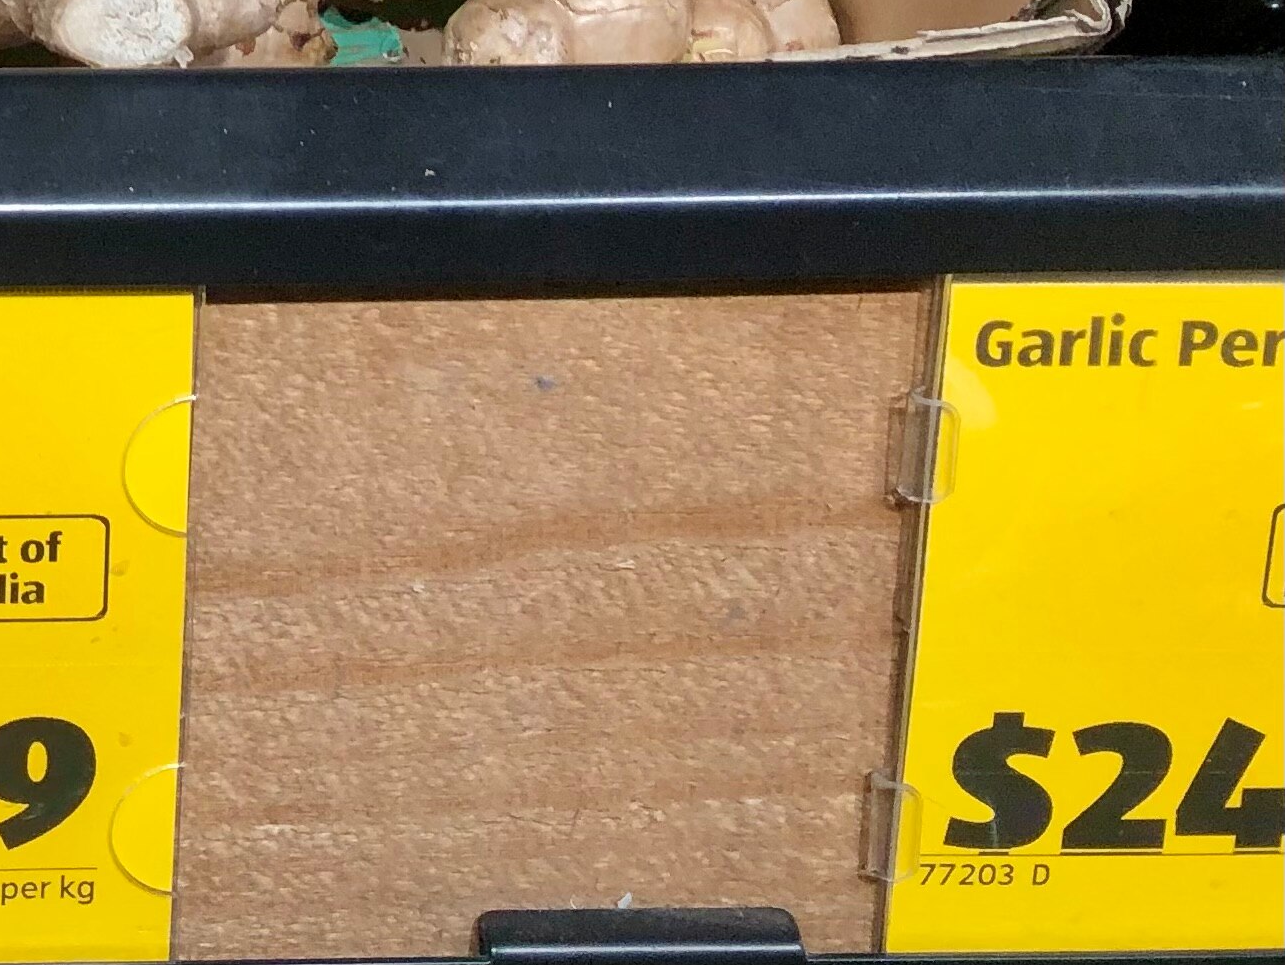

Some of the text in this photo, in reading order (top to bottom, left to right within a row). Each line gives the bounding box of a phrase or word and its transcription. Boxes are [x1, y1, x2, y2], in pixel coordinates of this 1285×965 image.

[975, 313, 1285, 367] Garlic Per
[20, 530, 63, 564] of
[943, 712, 1285, 852] $24
[1, 881, 51, 906] per
[60, 874, 96, 905] kg
[920, 863, 1051, 886] 77203 D
